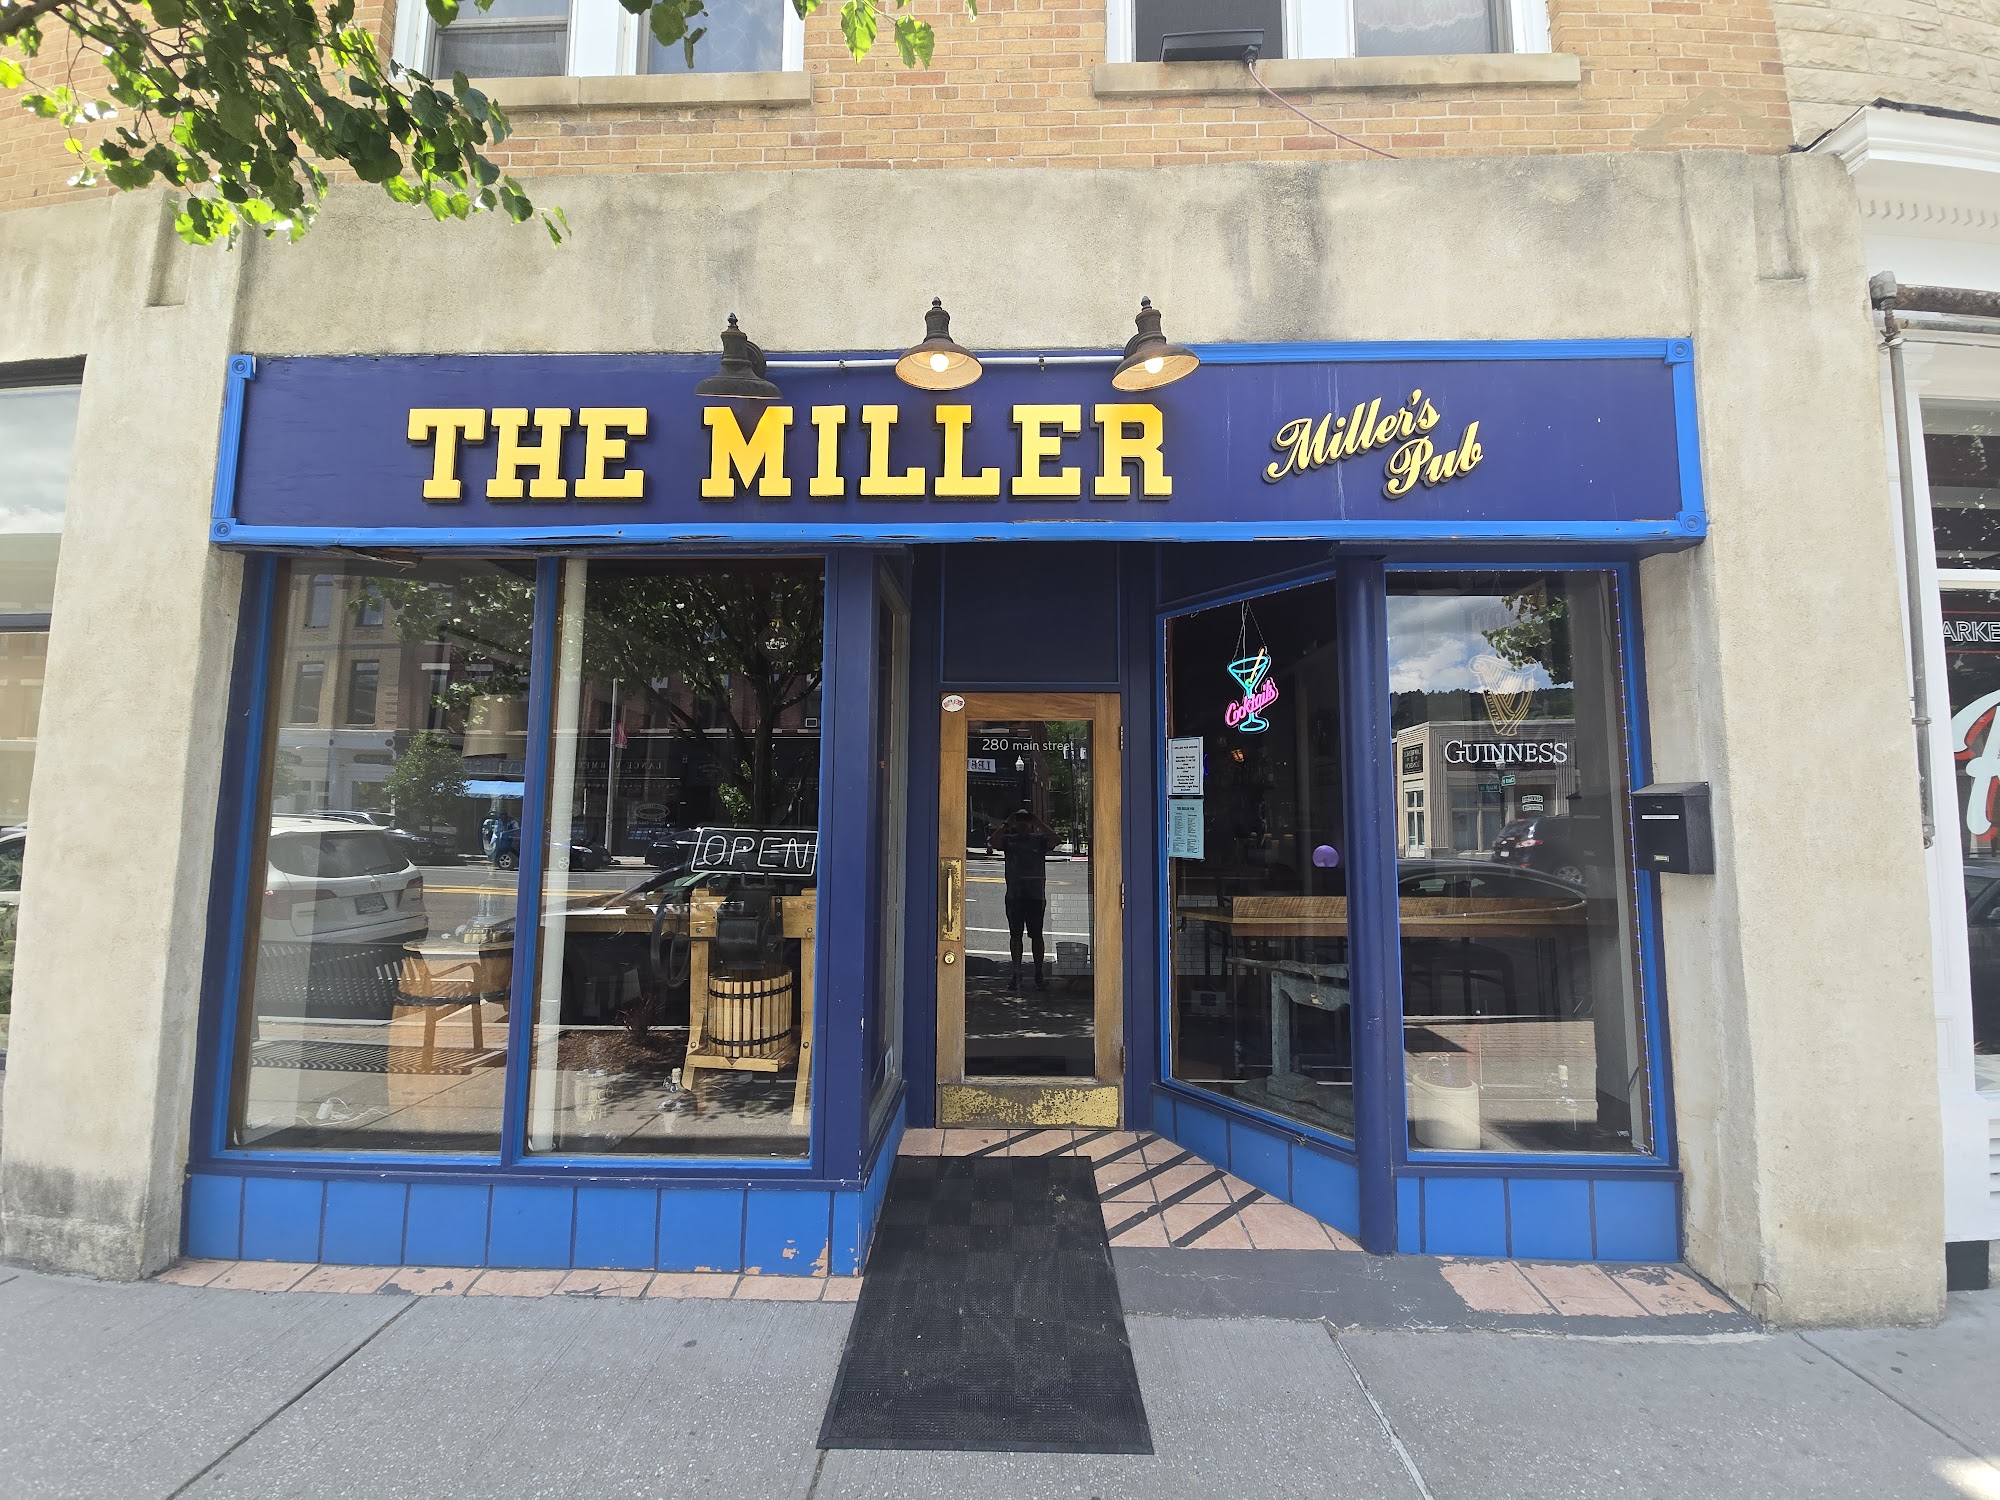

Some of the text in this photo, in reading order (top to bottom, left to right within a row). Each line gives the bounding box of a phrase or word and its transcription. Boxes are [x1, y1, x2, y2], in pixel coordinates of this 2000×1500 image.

[407, 403, 1174, 499] THE MILLER
[1264, 388, 1441, 480] Miller's
[1384, 420, 1484, 496] Pub
[1225, 678, 1279, 727] Cocktails
[981, 738, 1075, 751] 280 main street
[1444, 739, 1568, 764] GUINNESS
[701, 834, 812, 869] OPEN
